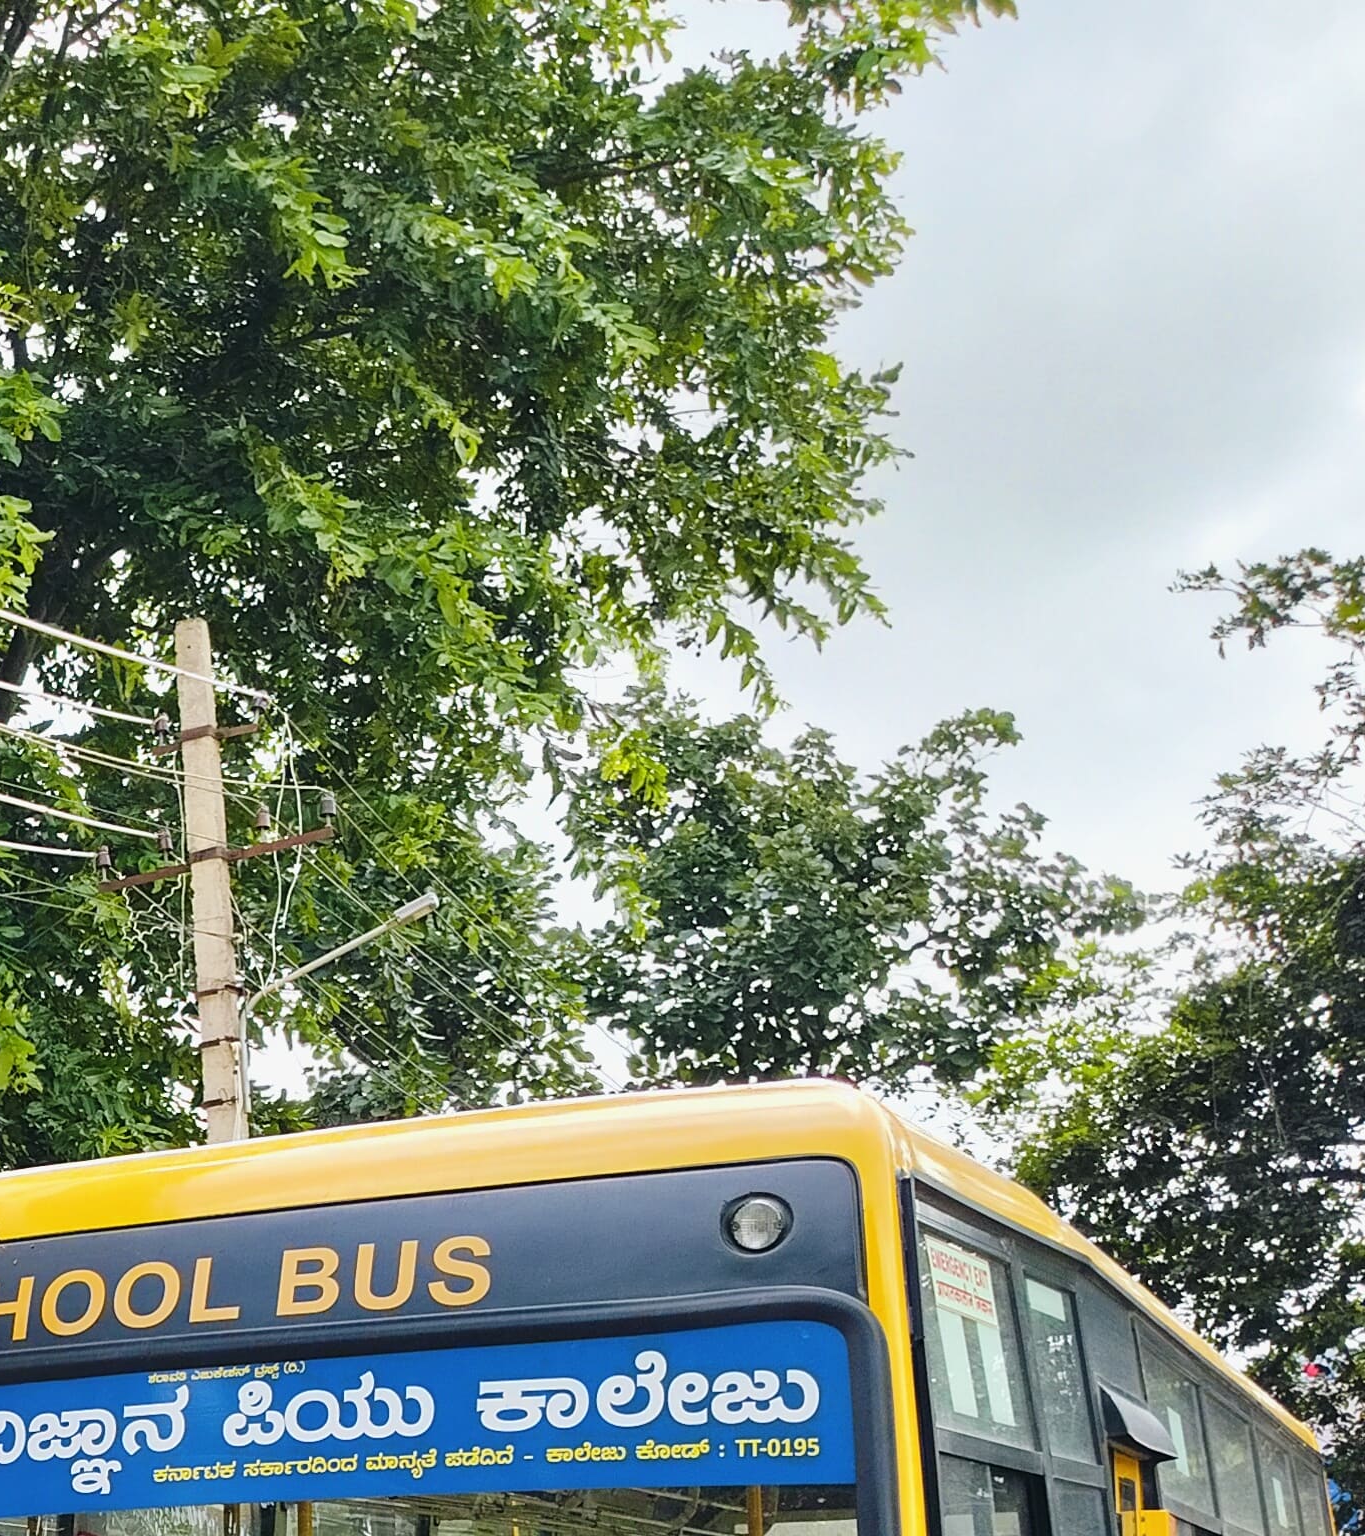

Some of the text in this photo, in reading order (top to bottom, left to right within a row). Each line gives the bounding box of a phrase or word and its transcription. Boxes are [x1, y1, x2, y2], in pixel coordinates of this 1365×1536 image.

[275, 1235, 493, 1317] BUS
[222, 1371, 435, 1446] ಪಿಯು
[476, 1349, 820, 1433] ಕಾಲೇಜು
[153, 1461, 236, 1482] ಕರ್ನಾಟಕ
[243, 1453, 358, 1478] ಸರ್ಕಾರದಿಂದ
[365, 1448, 437, 1479] ಮಾನ್ಯತೆ
[445, 1445, 514, 1466] ಪಡೆದಿದೆ
[545, 1441, 627, 1464] ಕಾಲೇಜು
[635, 1438, 711, 1461] ಕೋಡ್
[734, 1437, 820, 1459] TT-0195
